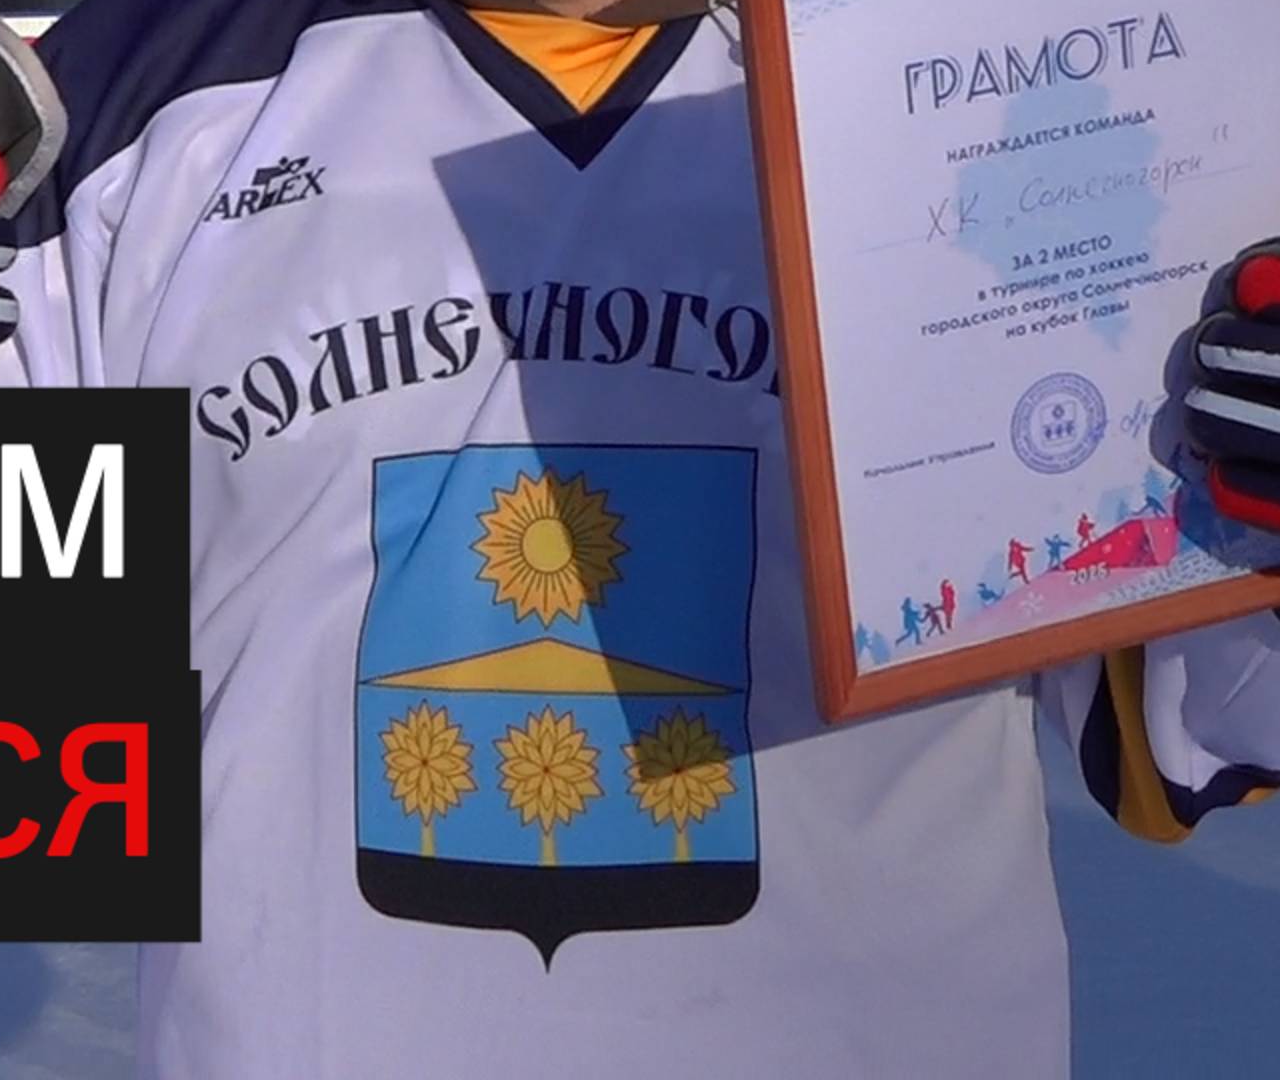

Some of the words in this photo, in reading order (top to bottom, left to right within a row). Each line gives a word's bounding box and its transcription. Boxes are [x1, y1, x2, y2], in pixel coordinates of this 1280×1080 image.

[904, 11, 1187, 115] ГРАМОТА
[946, 124, 1070, 164] НАГРАЖДАЕТСЯ
[1073, 107, 1156, 137] КОМАНДА
[978, 290, 987, 301] в
[990, 272, 1061, 303] турнире
[1065, 265, 1086, 282] по
[1090, 250, 1150, 275] хоккею
[1011, 252, 1034, 271] ЗА
[1039, 249, 1049, 265] 2
[1053, 234, 1113, 262] МЕСТО
[920, 304, 1018, 338] городского
[1021, 289, 1079, 318] округа
[1081, 259, 1209, 300] Солнечногорск
[1005, 324, 1027, 340] на
[1030, 310, 1079, 336] кубок
[1082, 298, 1131, 321] Главы
[195, 281, 780, 463] СОЛНЕЧНОГО
